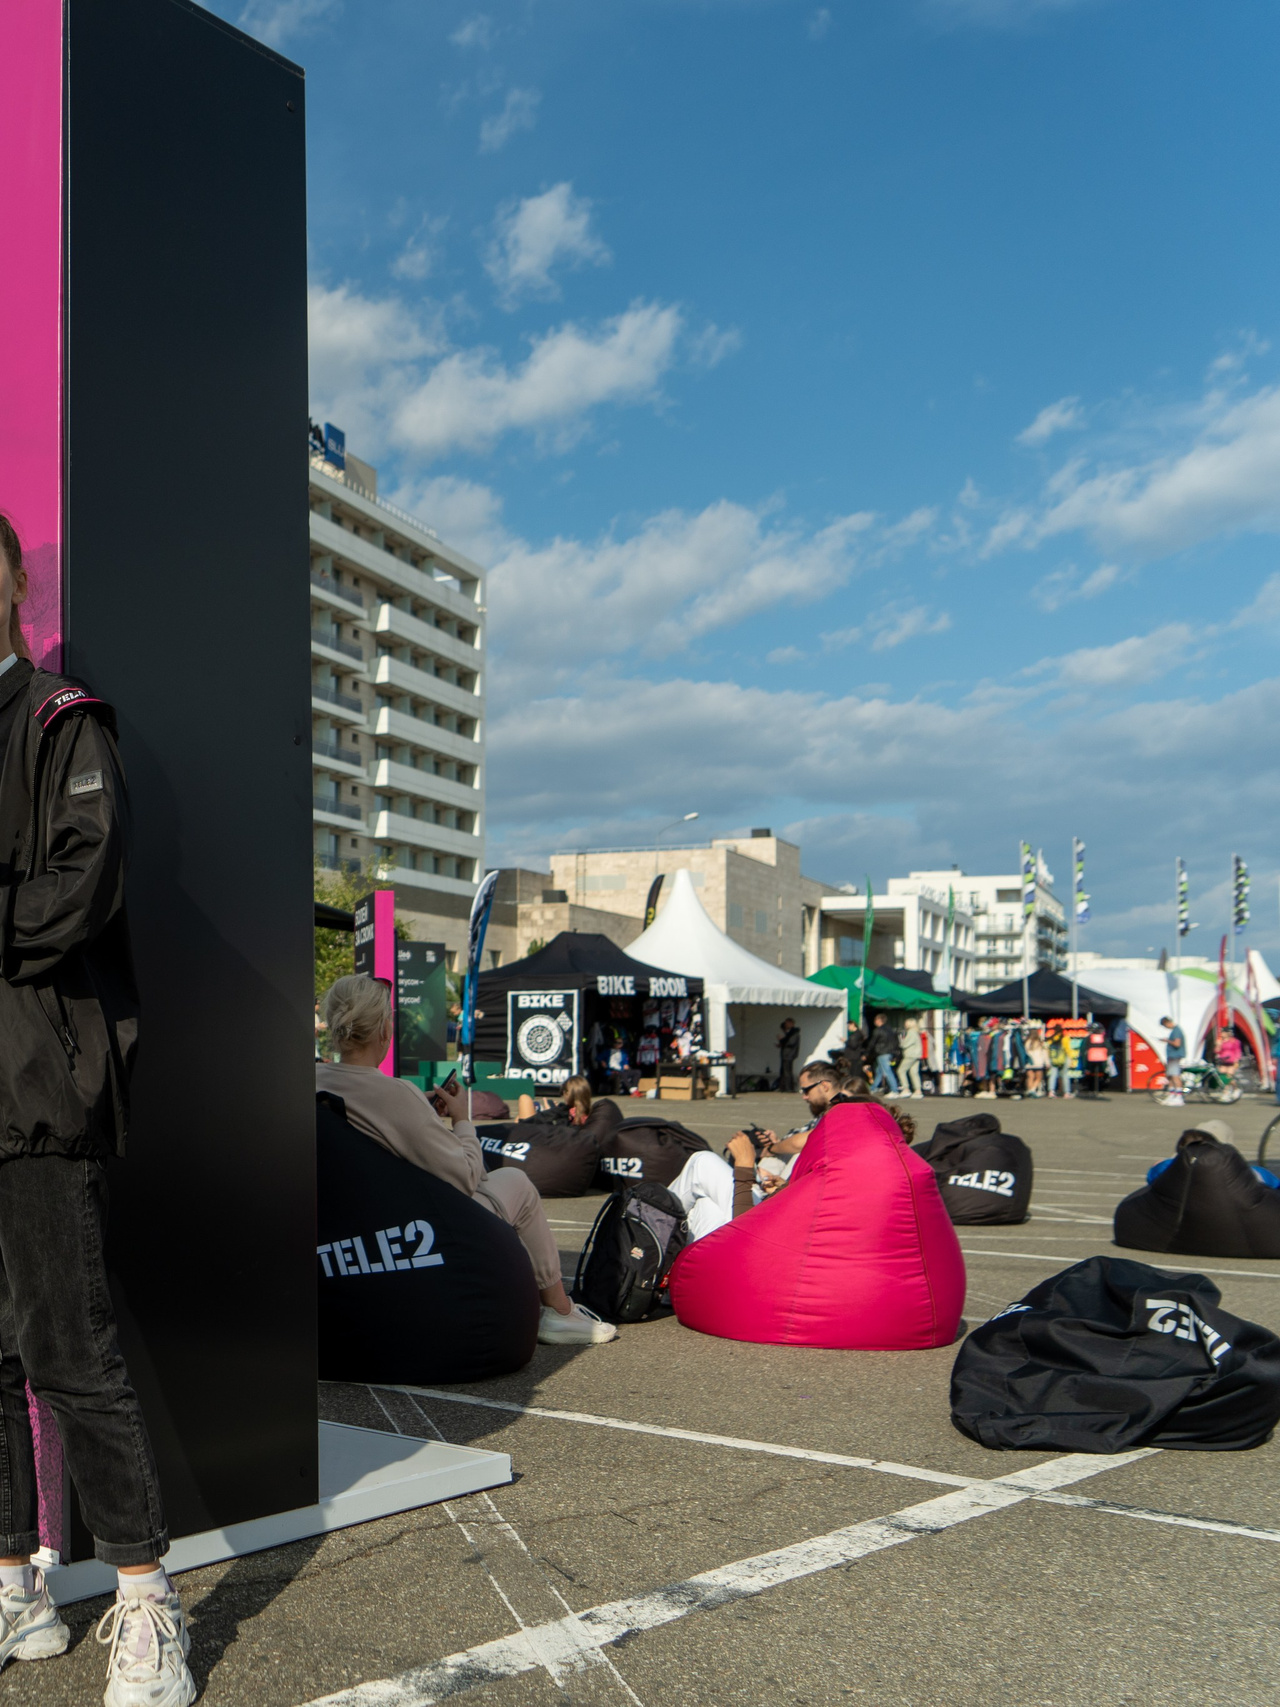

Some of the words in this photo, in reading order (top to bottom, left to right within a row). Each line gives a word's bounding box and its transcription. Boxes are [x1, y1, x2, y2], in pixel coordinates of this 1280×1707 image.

[597, 975, 636, 996] BIKE
[648, 977, 687, 998] ROOM
[517, 994, 565, 1009] BIKE
[479, 1136, 531, 1162] TELE2
[317, 1219, 445, 1278] TELE2
